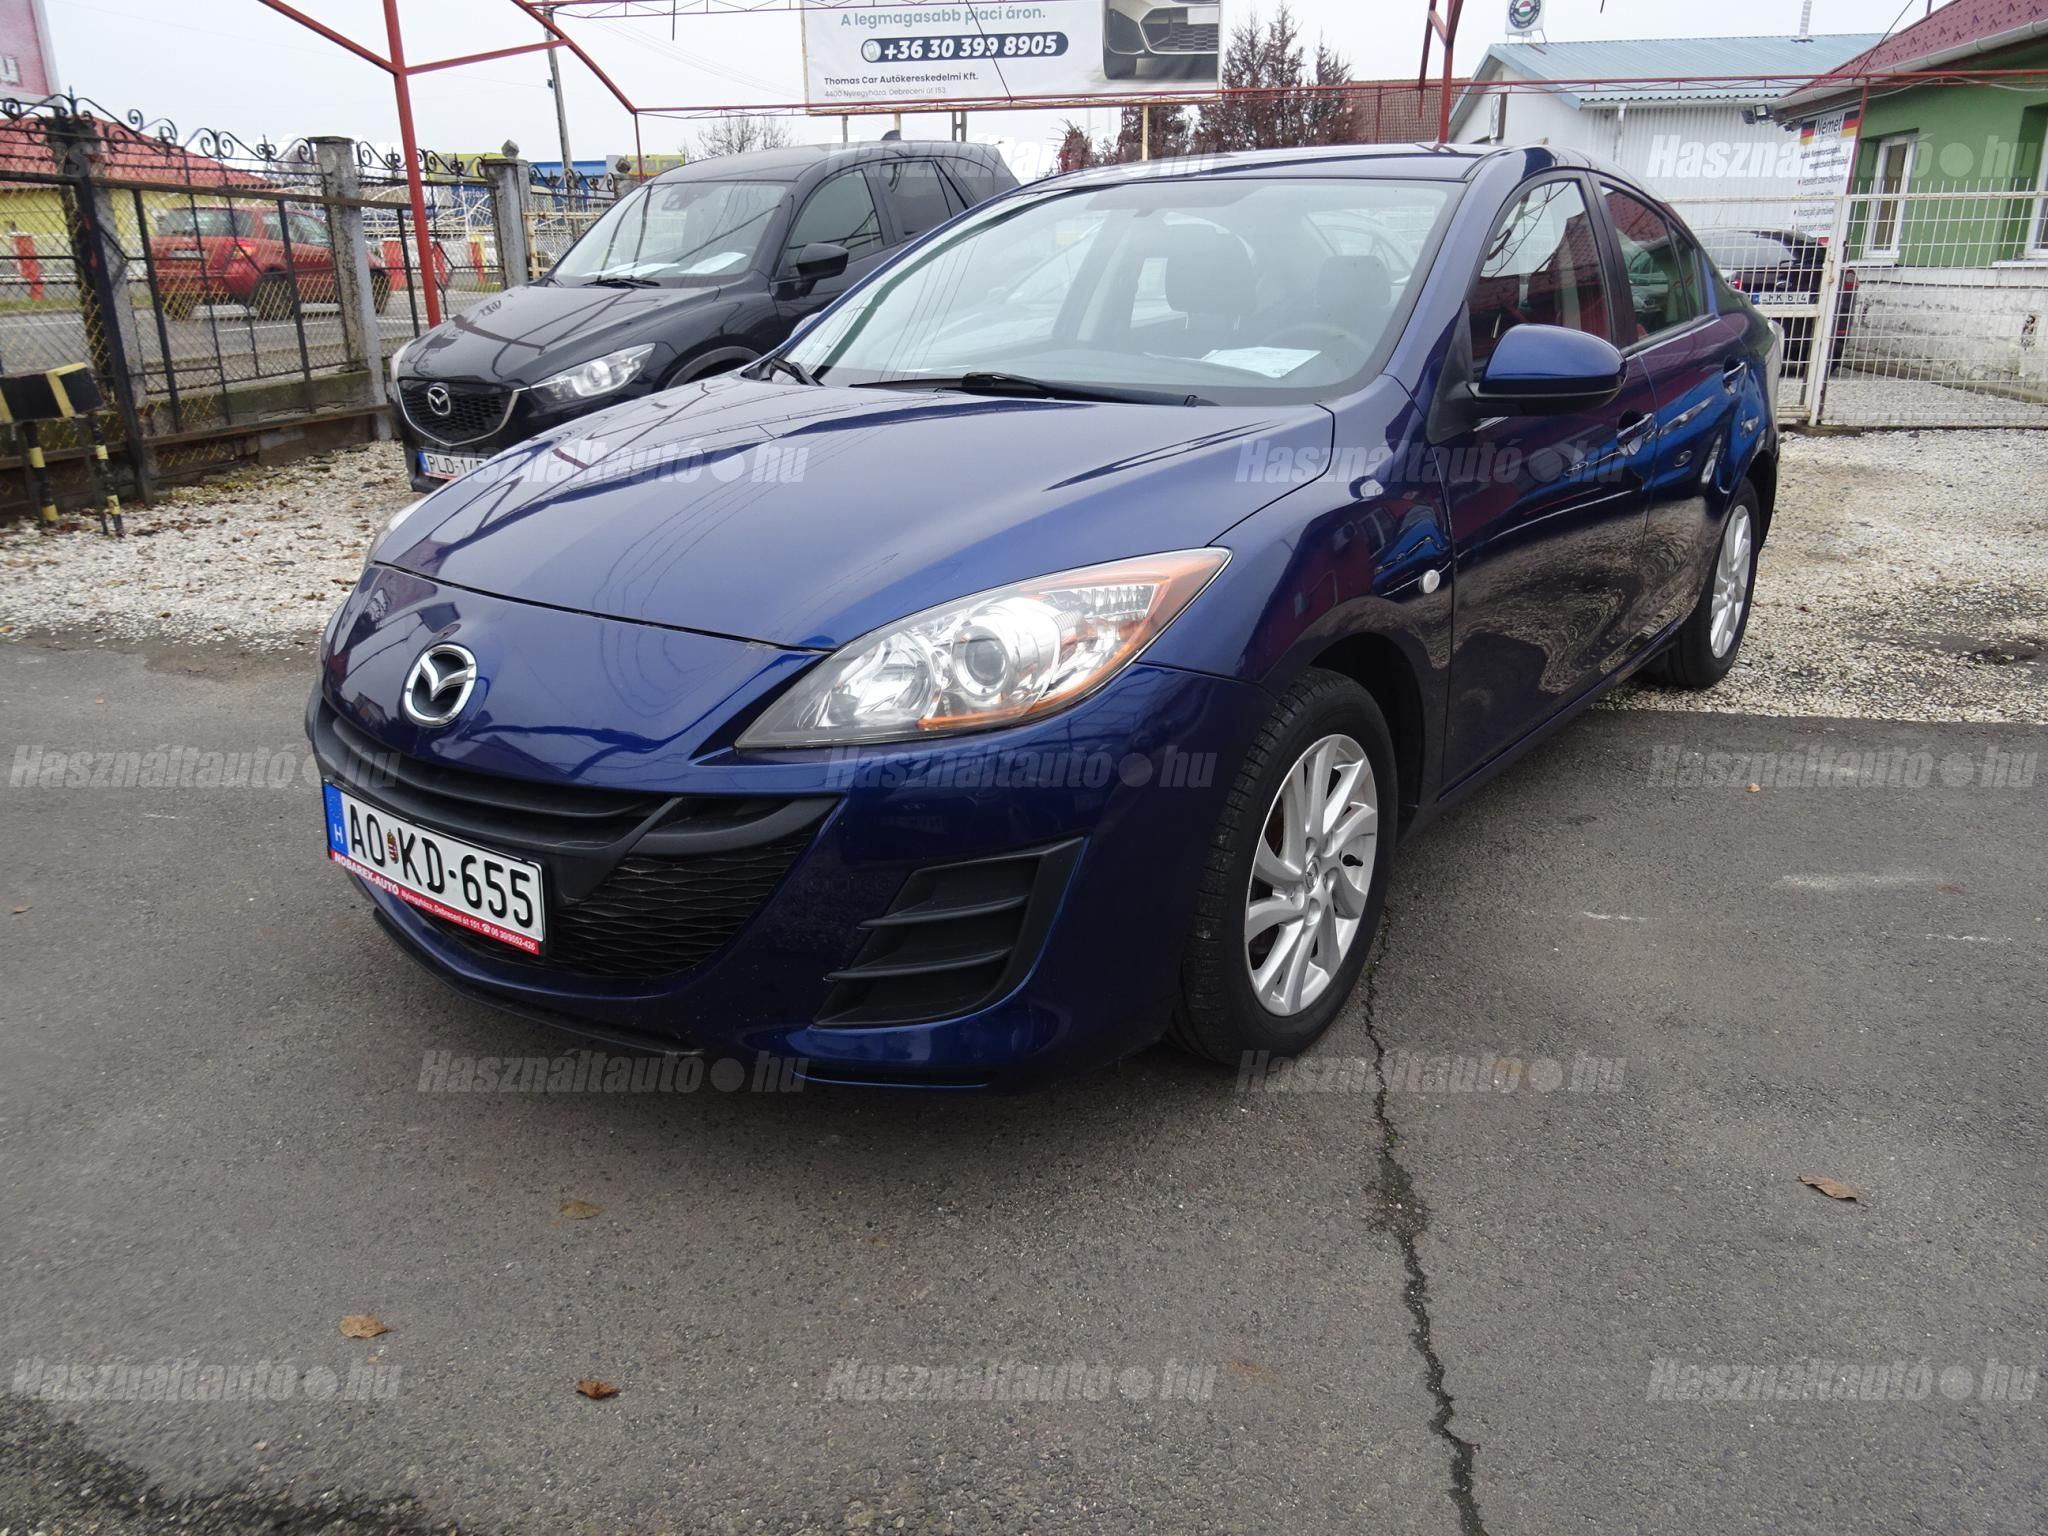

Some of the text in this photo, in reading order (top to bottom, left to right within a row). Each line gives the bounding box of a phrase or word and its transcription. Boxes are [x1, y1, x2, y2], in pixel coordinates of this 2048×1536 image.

[841, 5, 1047, 29] A legmagasabb piaci áron.
[884, 34, 1058, 60] +36 30 399 8905
[824, 71, 979, 86] Thomas Car Autókereskedelmi Kft.
